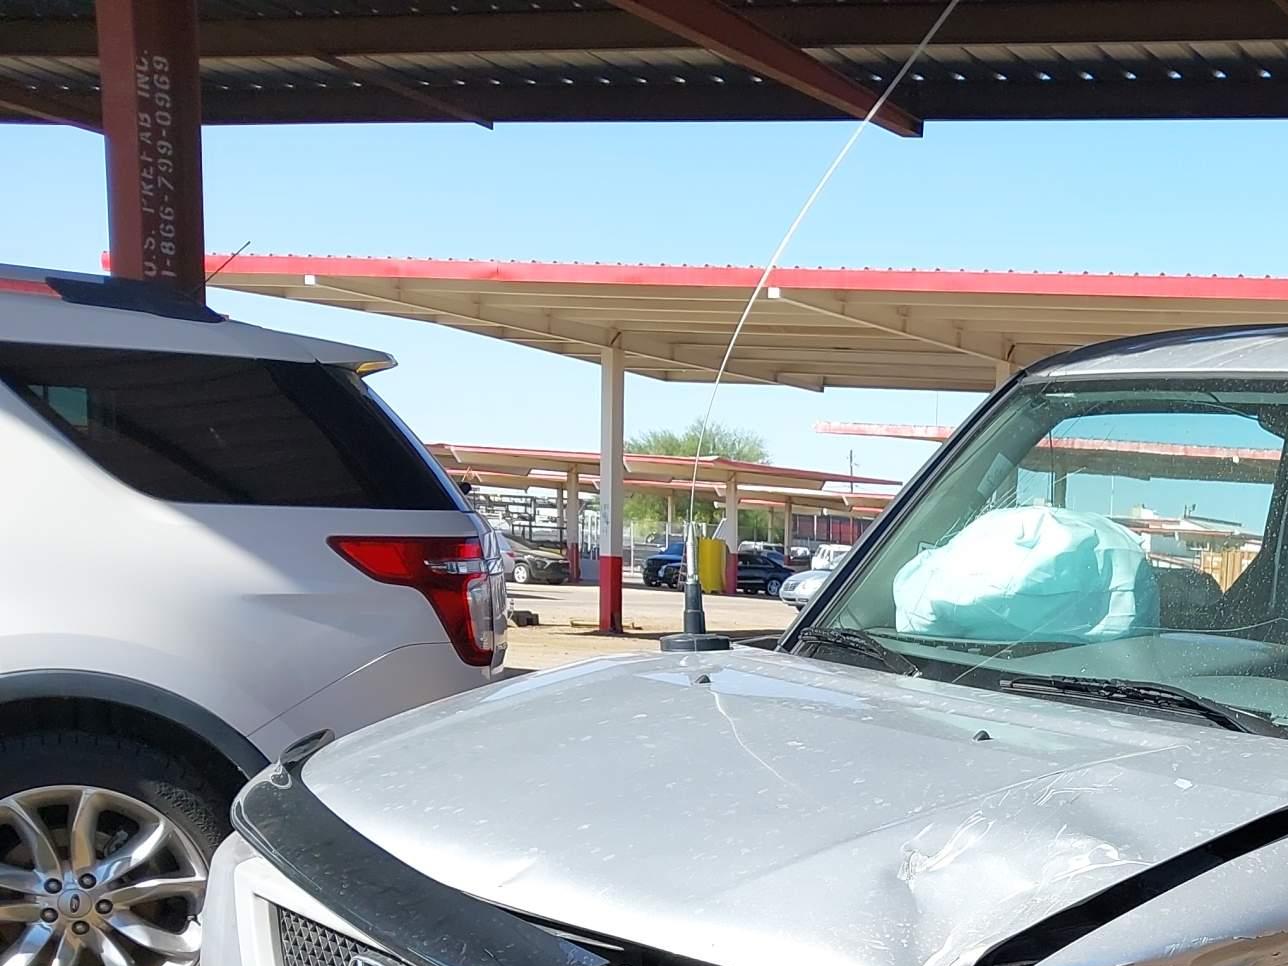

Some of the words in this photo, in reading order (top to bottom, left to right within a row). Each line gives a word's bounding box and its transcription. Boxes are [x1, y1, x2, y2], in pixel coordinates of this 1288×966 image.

[136, 50, 151, 98] INC.
[138, 111, 155, 214] PREFAB
[152, 55, 177, 277] 1-866-799-0969
[143, 229, 157, 277] U.S.
